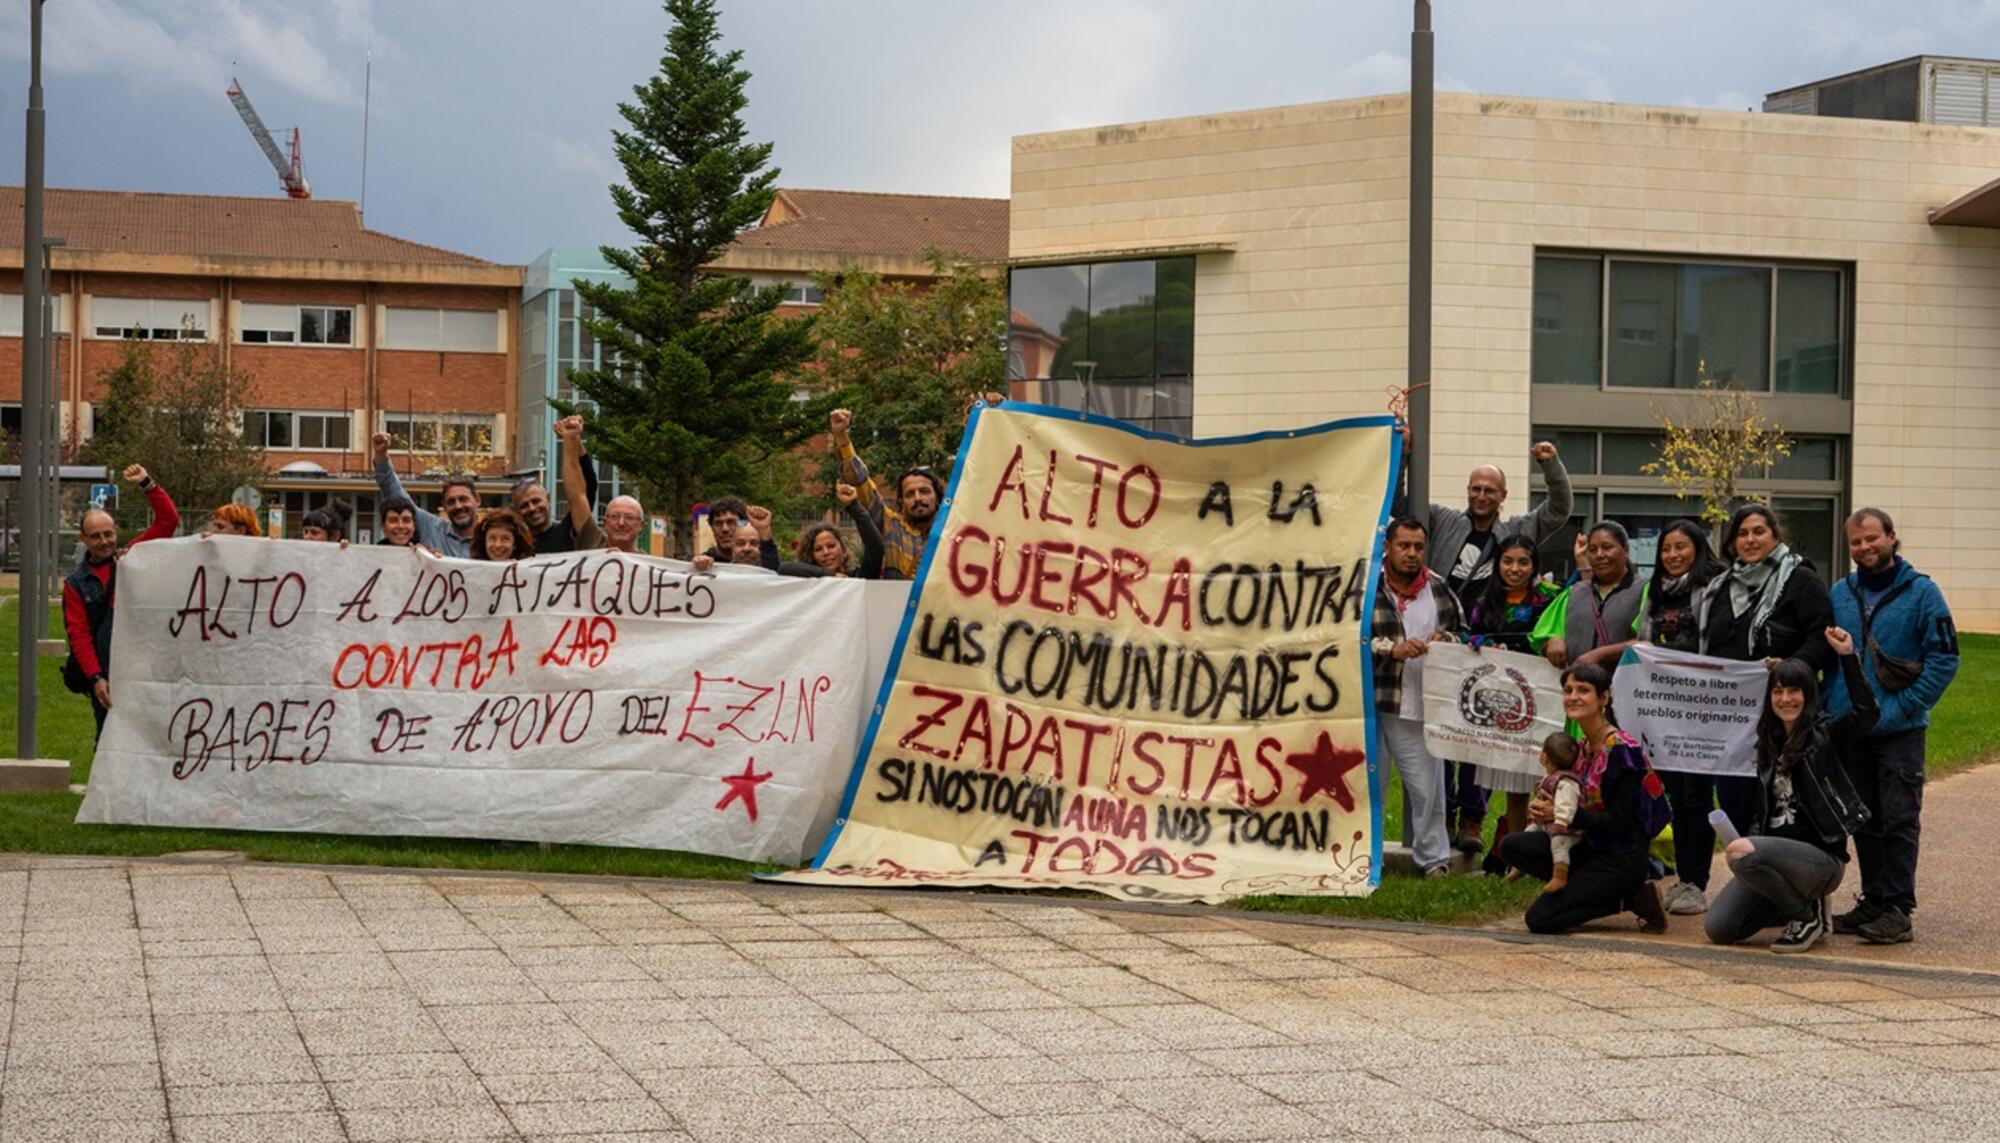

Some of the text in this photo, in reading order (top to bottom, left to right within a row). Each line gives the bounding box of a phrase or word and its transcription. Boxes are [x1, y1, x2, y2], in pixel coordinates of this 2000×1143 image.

[989, 444, 1322, 529] ALTO A LA
[169, 556, 717, 641] ALTO A LOS ATAQUES
[949, 525, 1367, 632] GUERRA CONTRA
[332, 616, 617, 690] CONTRA LAS
[919, 613, 1340, 720] LAS COMUNIDADES
[1650, 673, 1738, 690] Respeto a libre
[168, 671, 830, 780] BASES DE APOYO DEL EZLN
[1685, 709, 1750, 724] originarios
[1721, 695, 1737, 706] de
[1740, 696, 1758, 708] los
[898, 685, 1283, 808] ZAPATISTAS
[876, 758, 915, 803] SI
[918, 763, 977, 813] NOS
[978, 773, 1065, 828] TOCAN
[1156, 804, 1212, 846] NOS
[1218, 808, 1329, 852] TOCAN
[975, 839, 1006, 867] A
